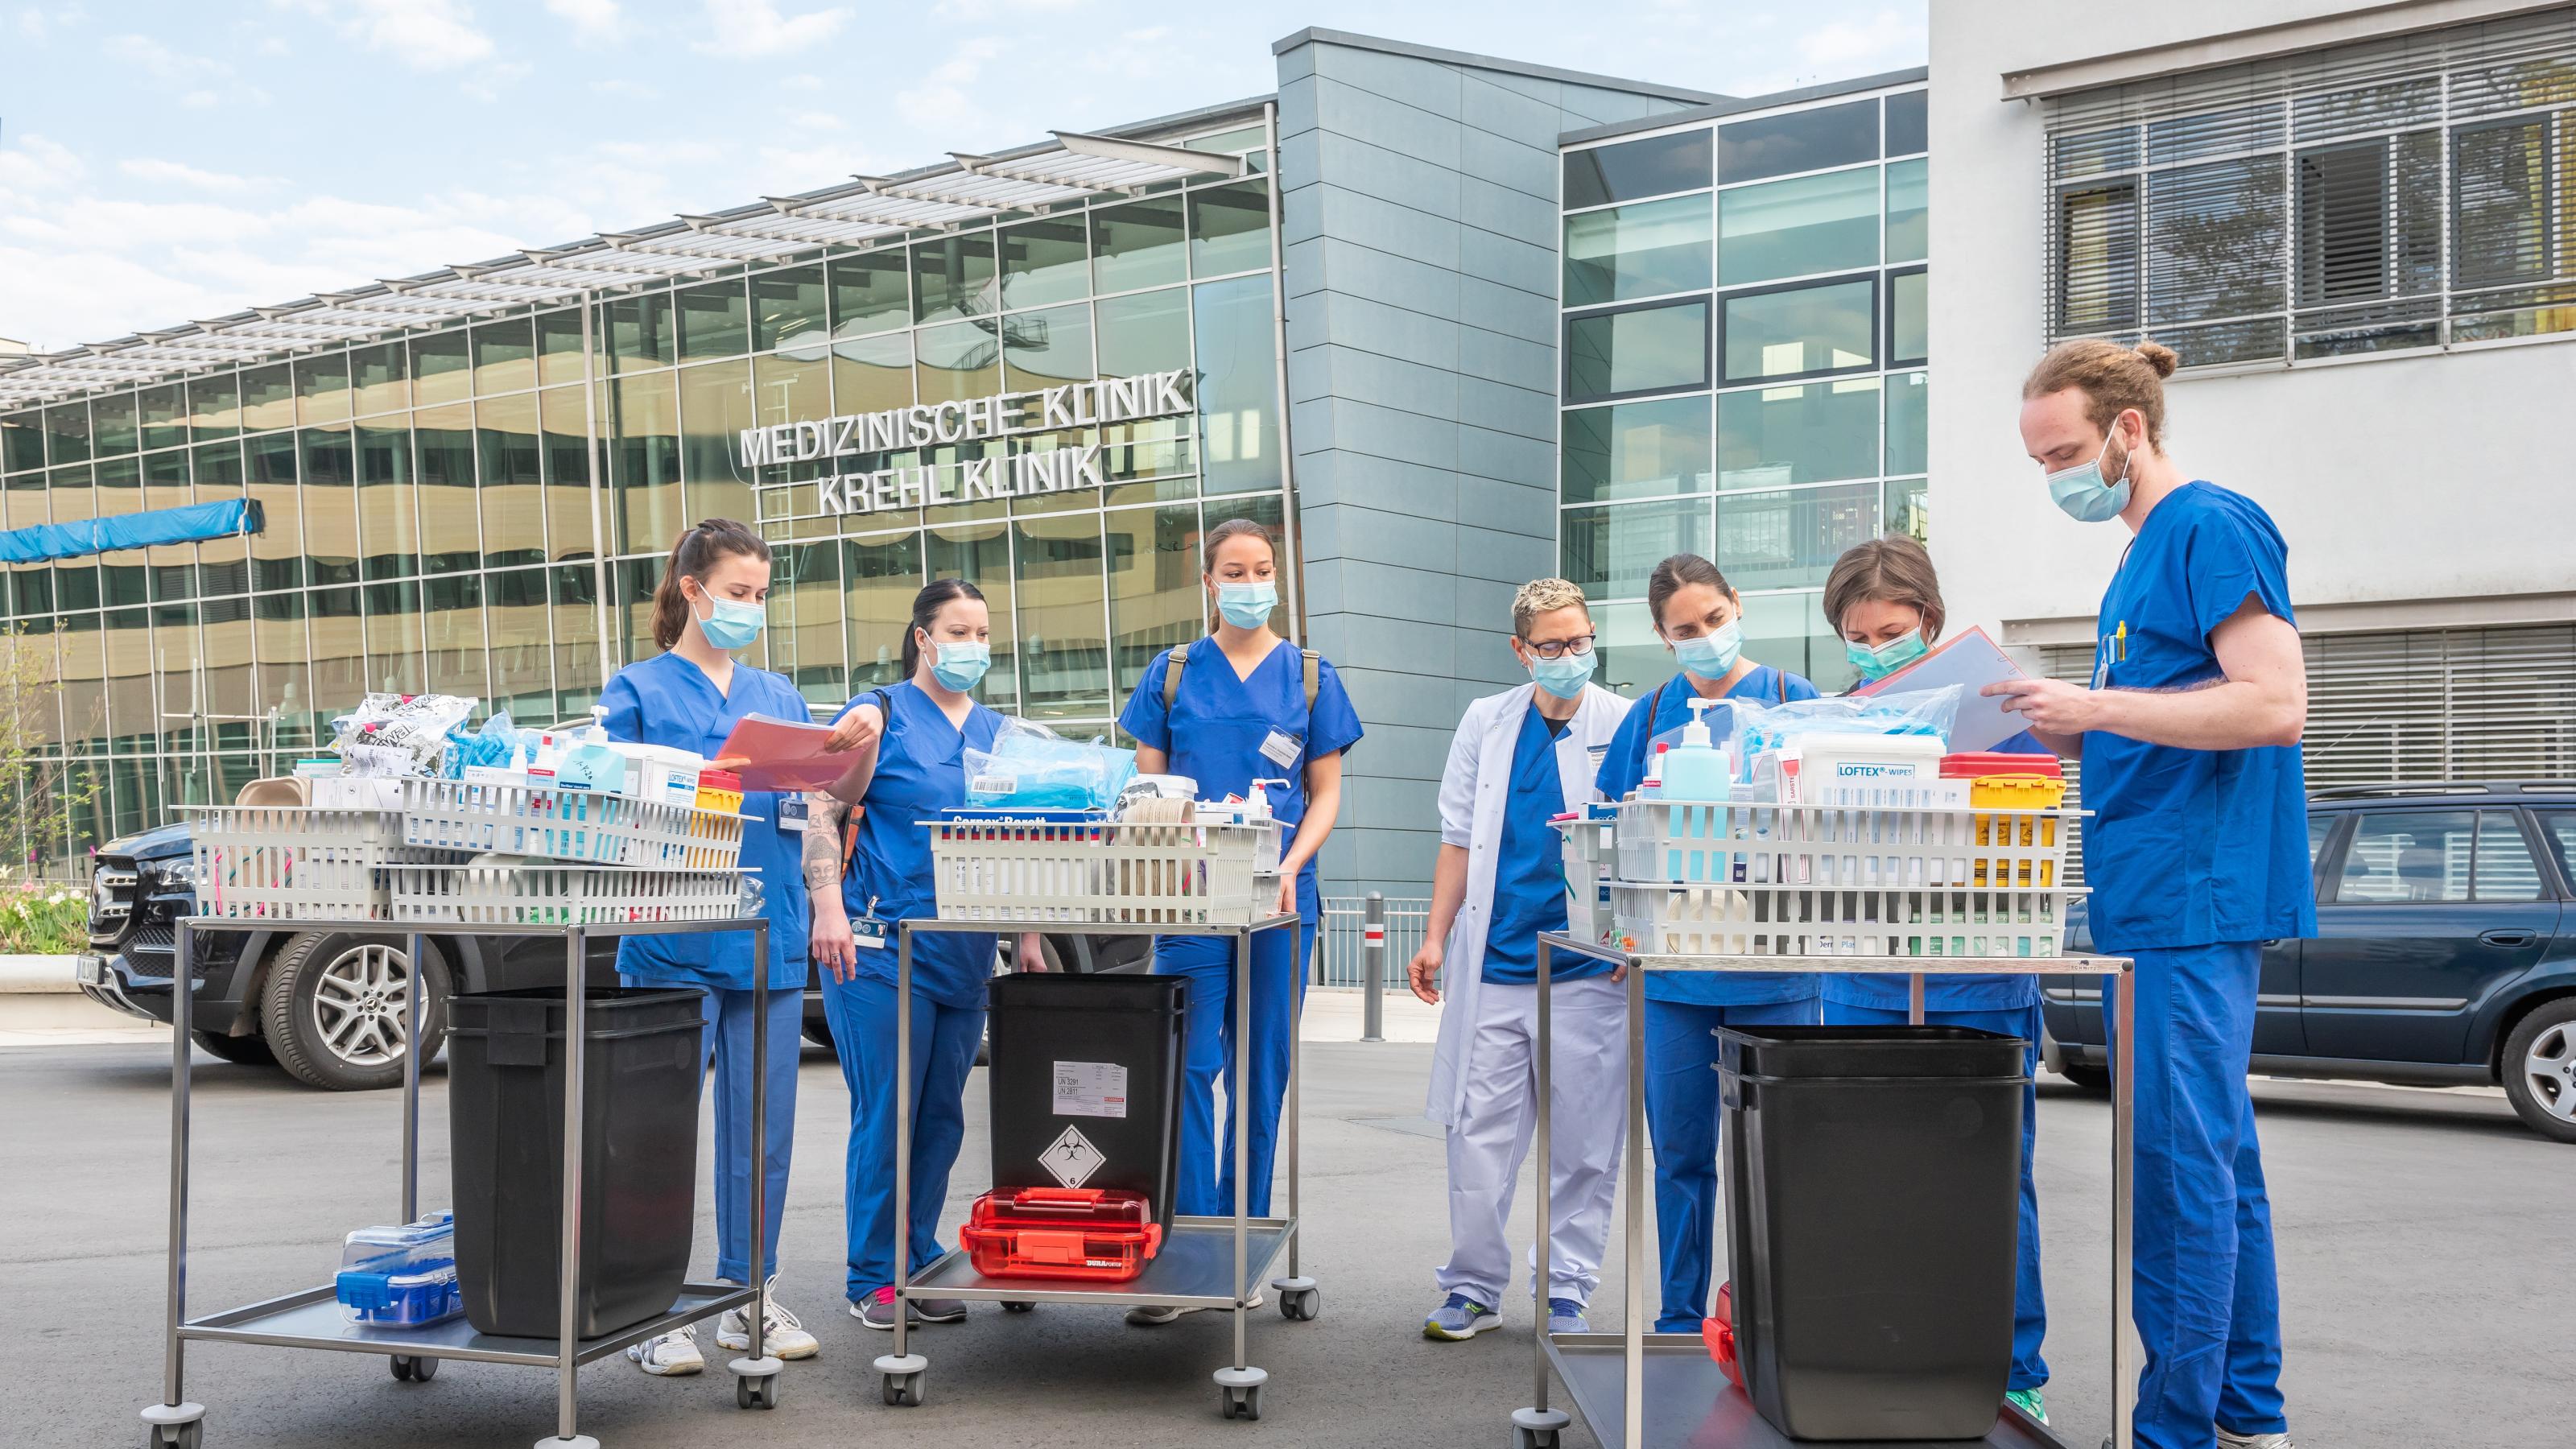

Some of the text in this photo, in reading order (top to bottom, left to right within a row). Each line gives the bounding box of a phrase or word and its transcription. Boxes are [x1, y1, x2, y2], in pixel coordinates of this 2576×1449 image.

[741, 369, 1193, 468] MEDIZINISCHE KLINIK
[818, 444, 1105, 517] KREHL KLINIK
[1067, 1078, 1079, 1086] 3291
[1069, 1177, 1076, 1185] 6
